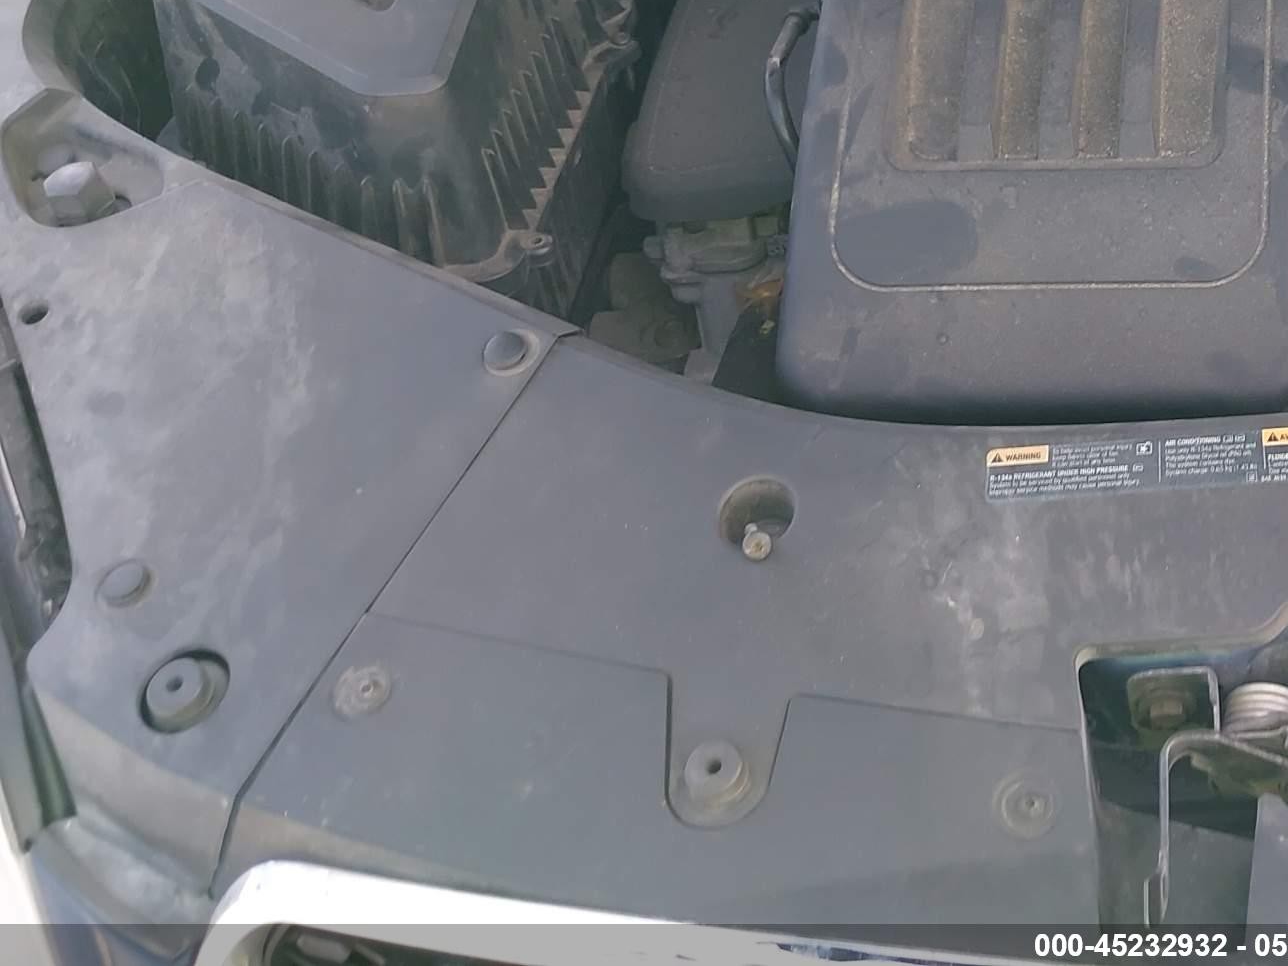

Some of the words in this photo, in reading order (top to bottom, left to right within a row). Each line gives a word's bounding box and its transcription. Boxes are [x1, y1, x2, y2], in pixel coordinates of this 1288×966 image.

[1005, 452, 1041, 462] WARNING
[1080, 467, 1096, 475] HIGH
[1096, 464, 1129, 474] PRESSURE
